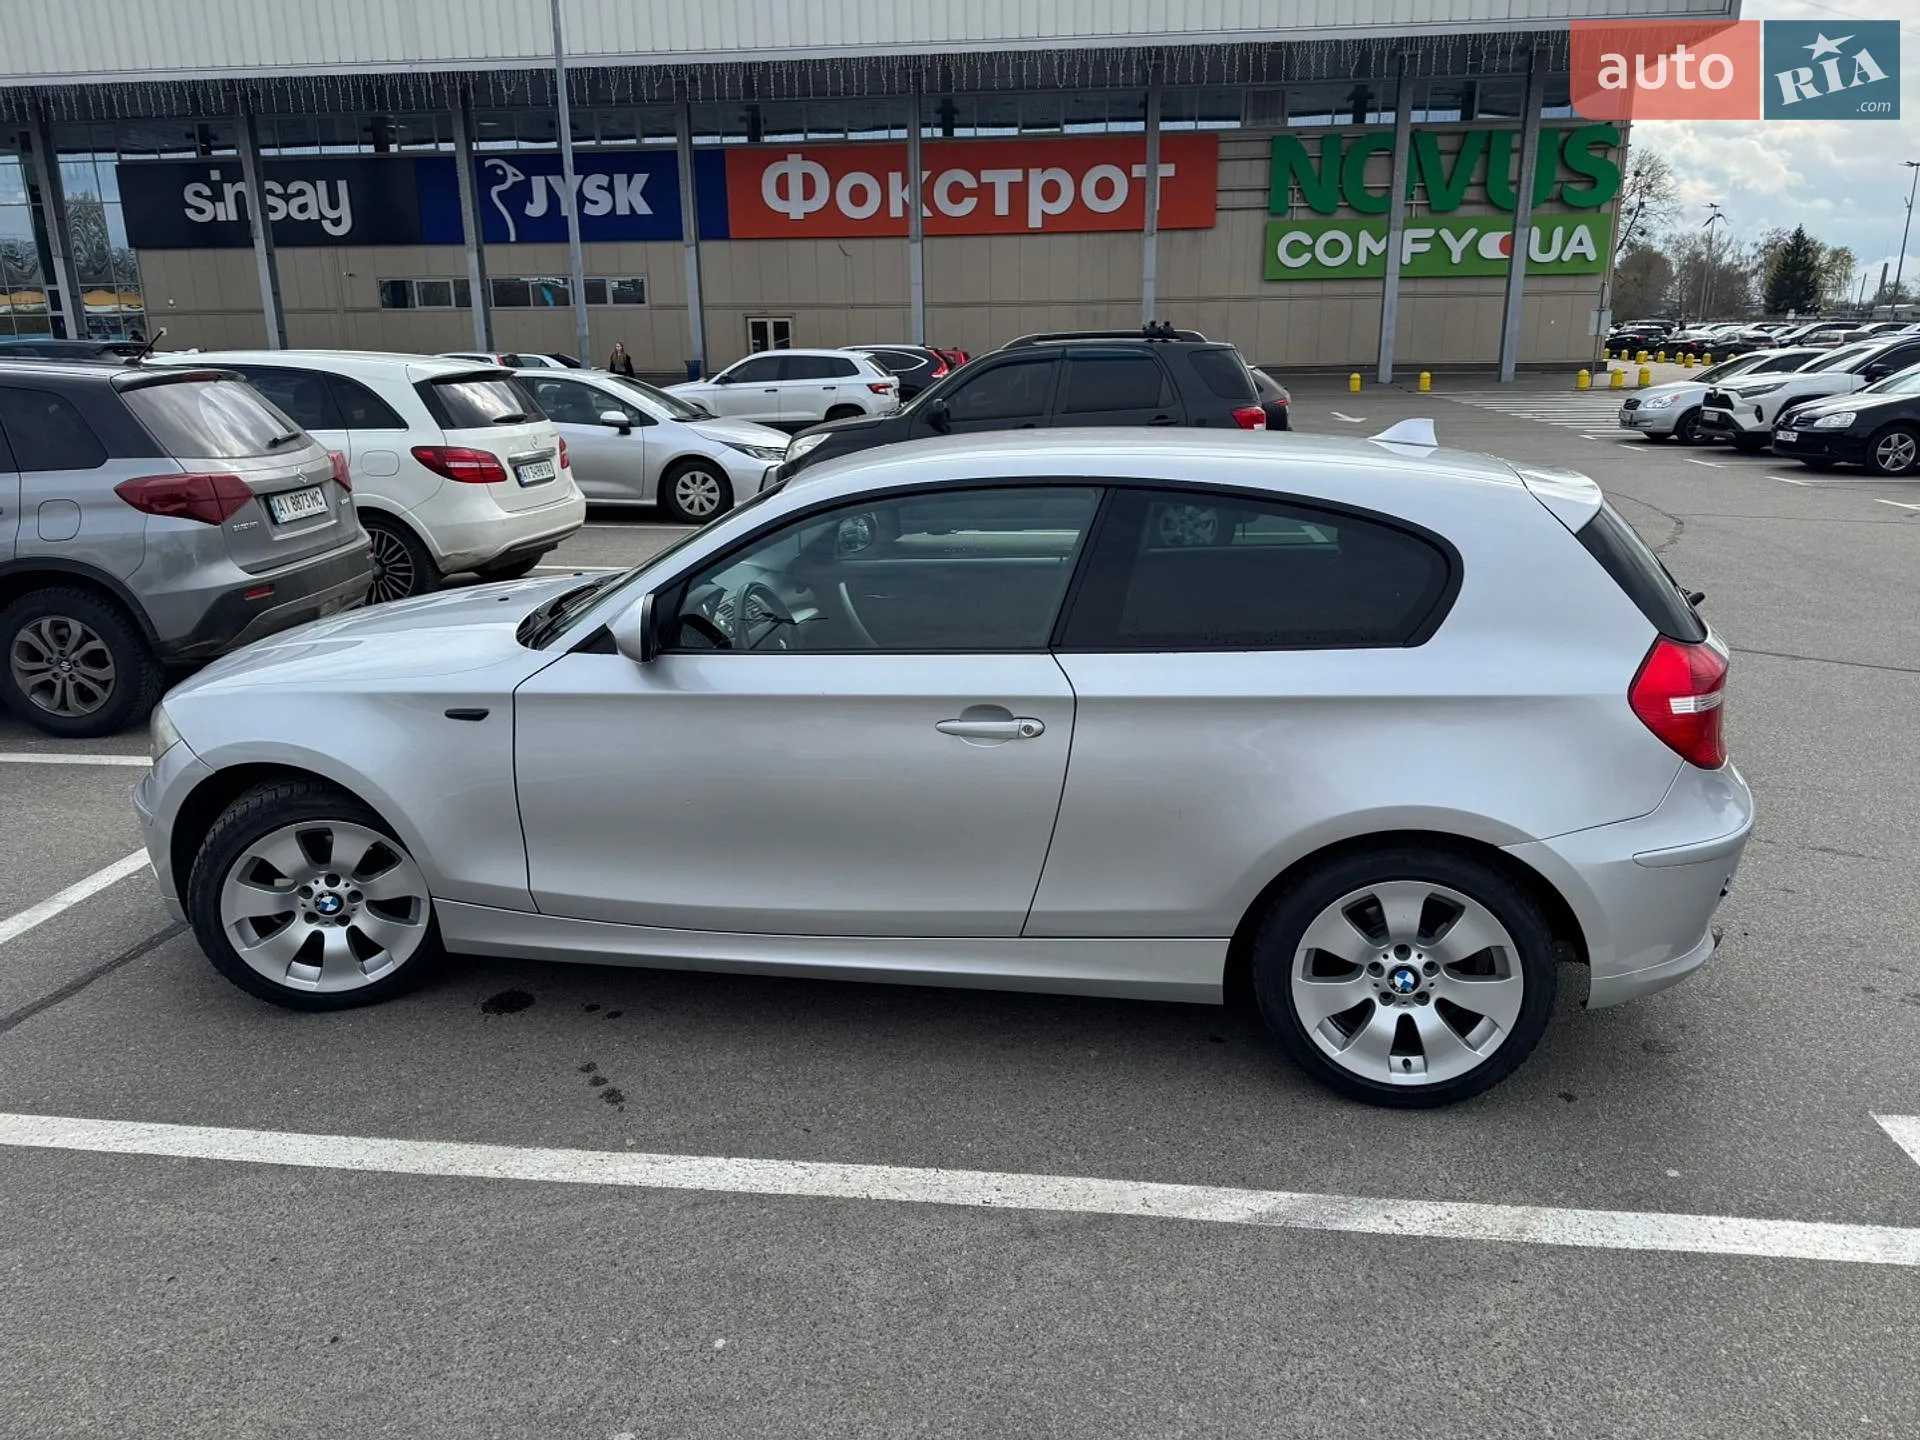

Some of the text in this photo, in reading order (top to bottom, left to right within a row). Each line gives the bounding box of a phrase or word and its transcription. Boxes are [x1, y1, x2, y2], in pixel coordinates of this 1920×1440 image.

[183, 169, 353, 236] sinsay
[524, 173, 654, 217] JYSK
[1268, 123, 1622, 216] NOVUS
